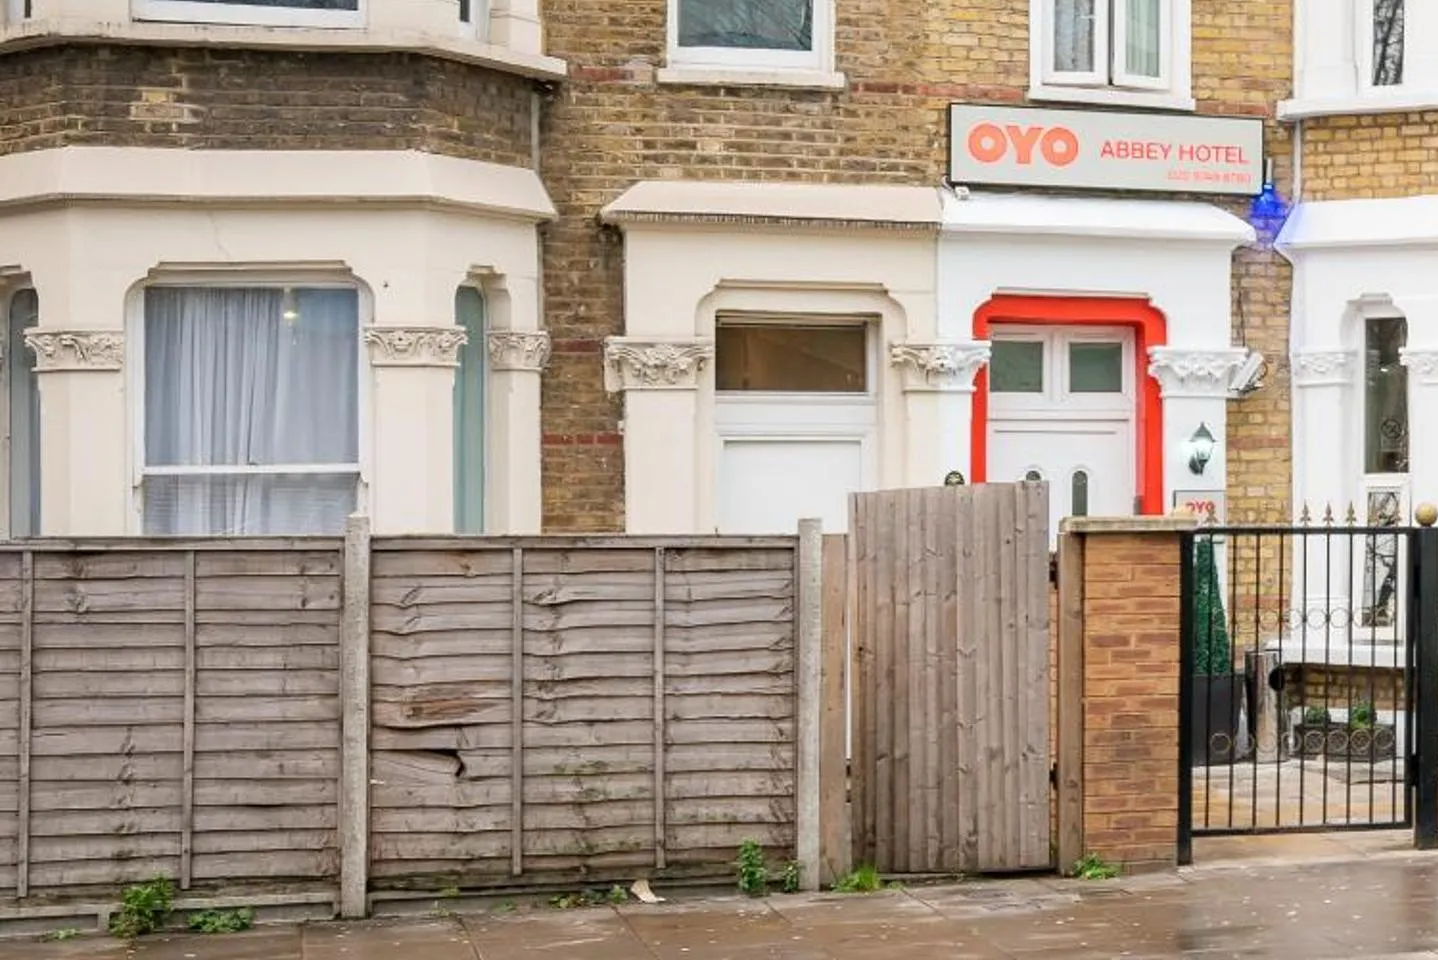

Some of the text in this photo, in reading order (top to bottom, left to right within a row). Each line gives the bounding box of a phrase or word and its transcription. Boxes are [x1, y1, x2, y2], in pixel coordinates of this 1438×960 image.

[968, 122, 1249, 167] OYO ABBEY HOTEL
